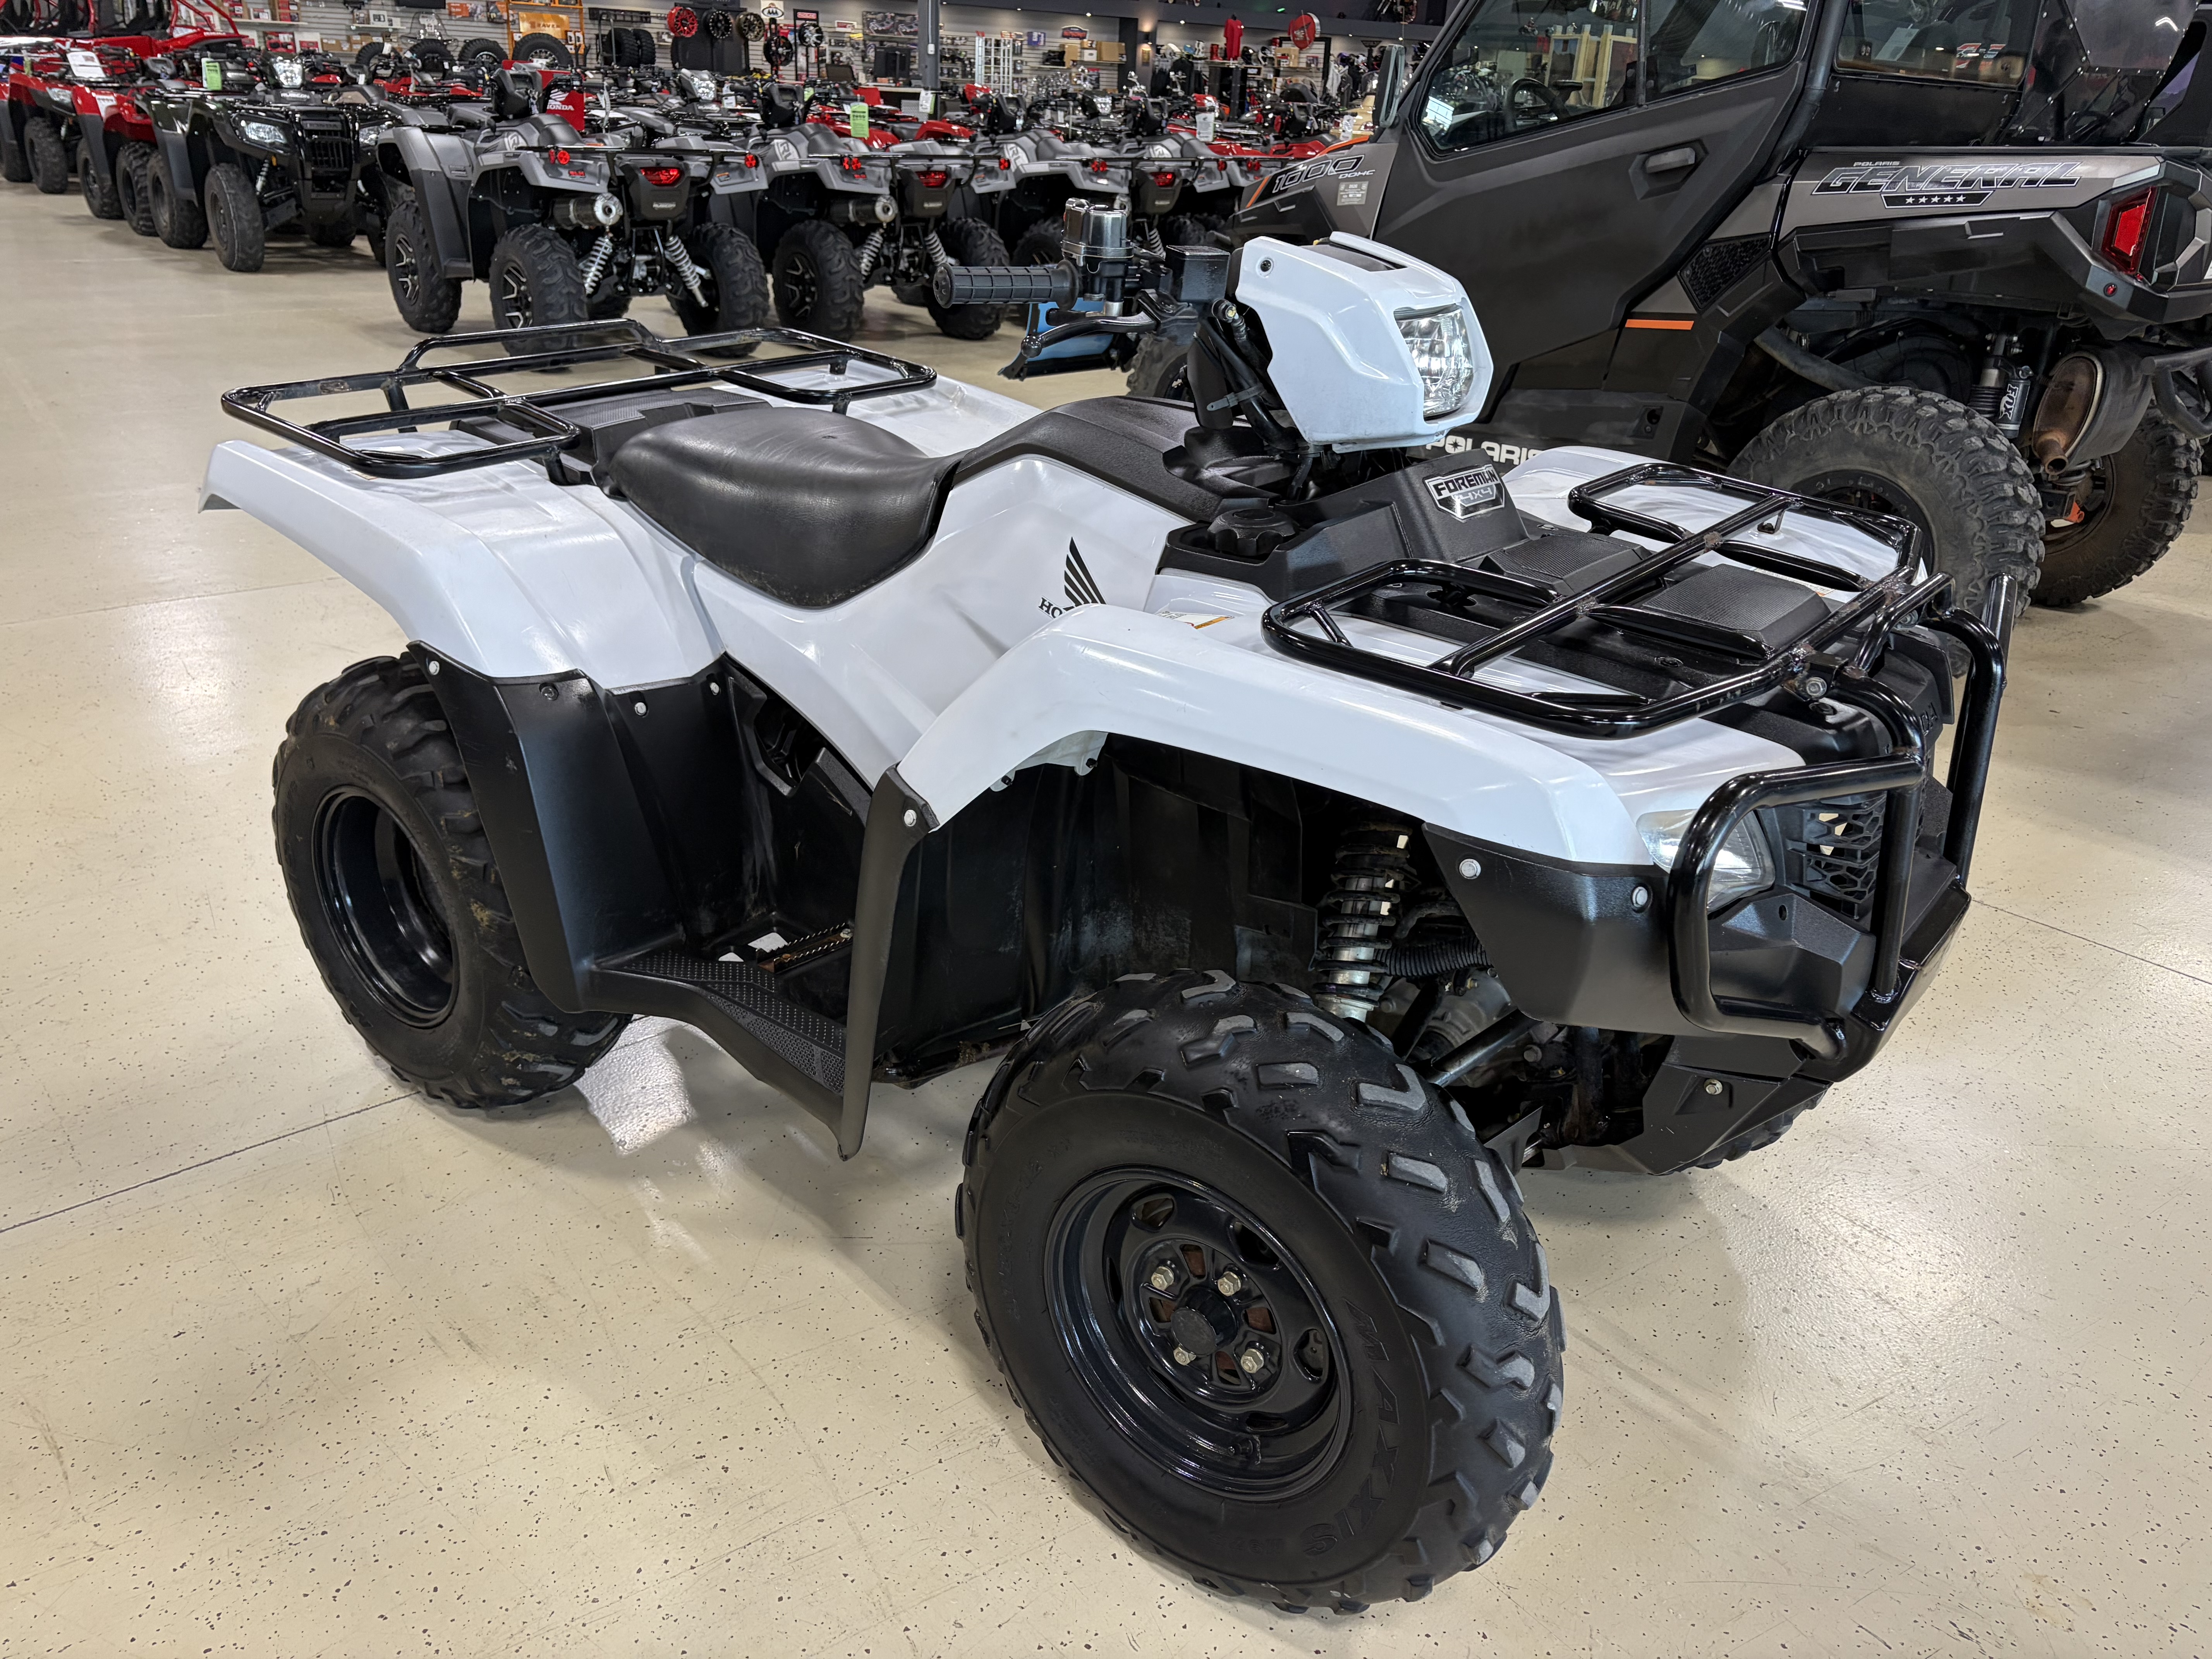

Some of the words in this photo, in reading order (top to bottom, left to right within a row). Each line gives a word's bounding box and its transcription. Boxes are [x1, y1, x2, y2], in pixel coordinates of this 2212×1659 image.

[1272, 155, 1365, 194] 1000
[1338, 170, 1376, 179] DOHC
[1812, 162, 2082, 195] GENERAL
[1999, 383, 2019, 420] FOX
[1432, 469, 1499, 497] FOREMAN
[1300, 1297, 1400, 1556] MAXXIS
